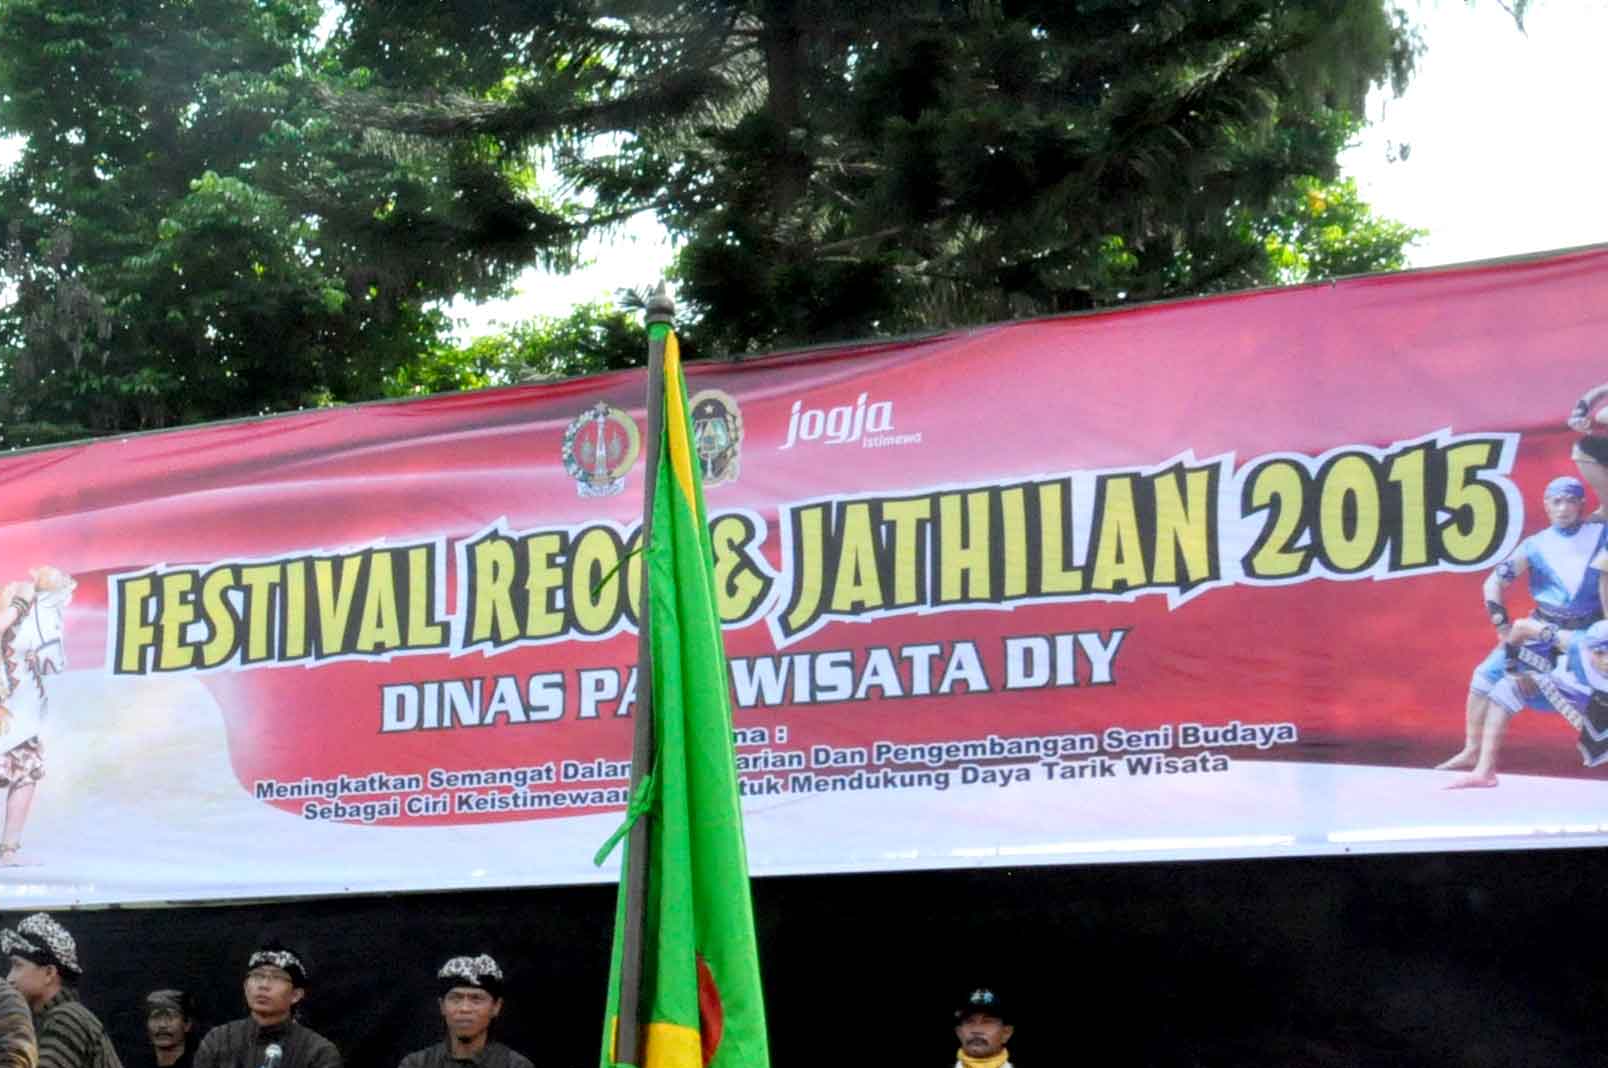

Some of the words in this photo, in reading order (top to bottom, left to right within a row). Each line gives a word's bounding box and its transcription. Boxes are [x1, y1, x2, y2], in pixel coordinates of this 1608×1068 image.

[777, 392, 894, 450] jogja
[113, 542, 450, 675] FESTIVAL
[710, 513, 773, 624] &
[778, 458, 1224, 637] JATHILAN
[1244, 434, 1510, 576] 2015
[379, 671, 565, 732] DINAS
[1004, 629, 1127, 691] DIY
[256, 772, 421, 800] Meningkatkan
[429, 766, 553, 789] Semangat
[813, 747, 865, 766] Dan
[876, 735, 1094, 763] Pengembangan
[1106, 727, 1170, 749] Seni
[1182, 723, 1294, 745] Budaya
[304, 796, 398, 822] Sebagai
[407, 796, 448, 816] Ciri
[791, 769, 950, 793] Mendukung
[961, 766, 1031, 788] Daya
[1042, 759, 1116, 780] Tarik
[1126, 754, 1228, 776] Wisata
